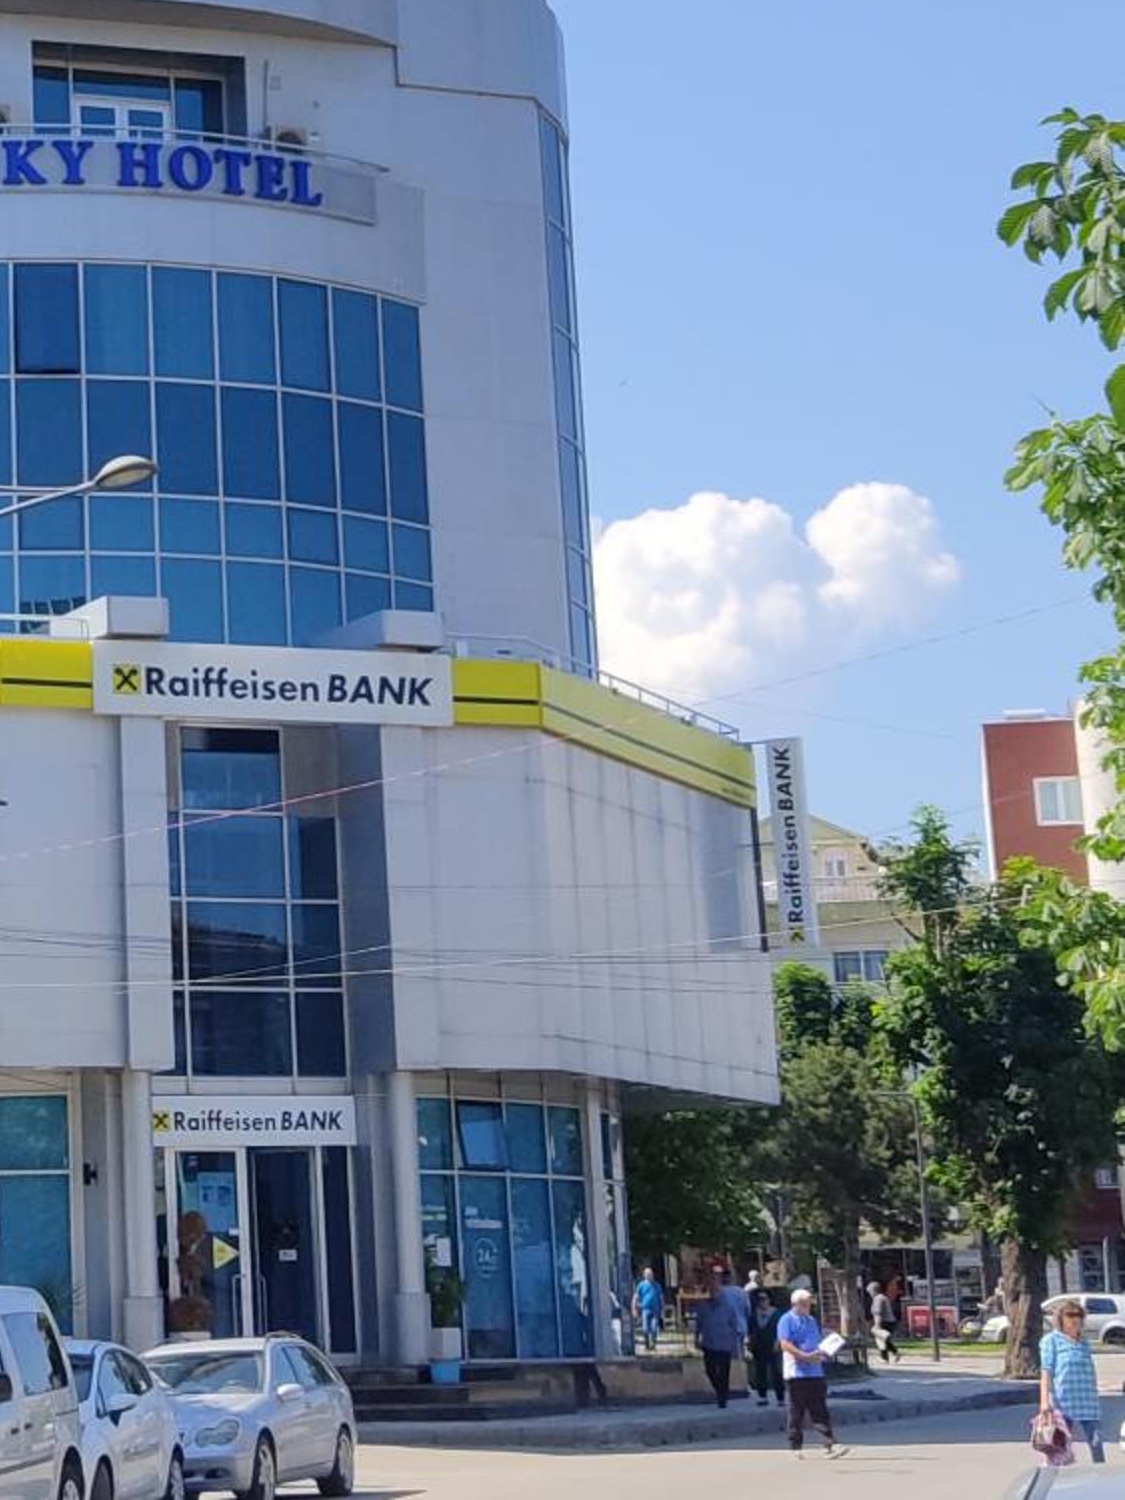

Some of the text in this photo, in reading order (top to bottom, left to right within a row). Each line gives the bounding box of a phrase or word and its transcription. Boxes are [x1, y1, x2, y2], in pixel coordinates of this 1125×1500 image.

[116, 141, 323, 207] HOTEL
[144, 666, 434, 706] Raiffeisen BANK
[773, 747, 804, 923] Raiffeisen BANK
[174, 1109, 344, 1132] Raiffeisen BANK
